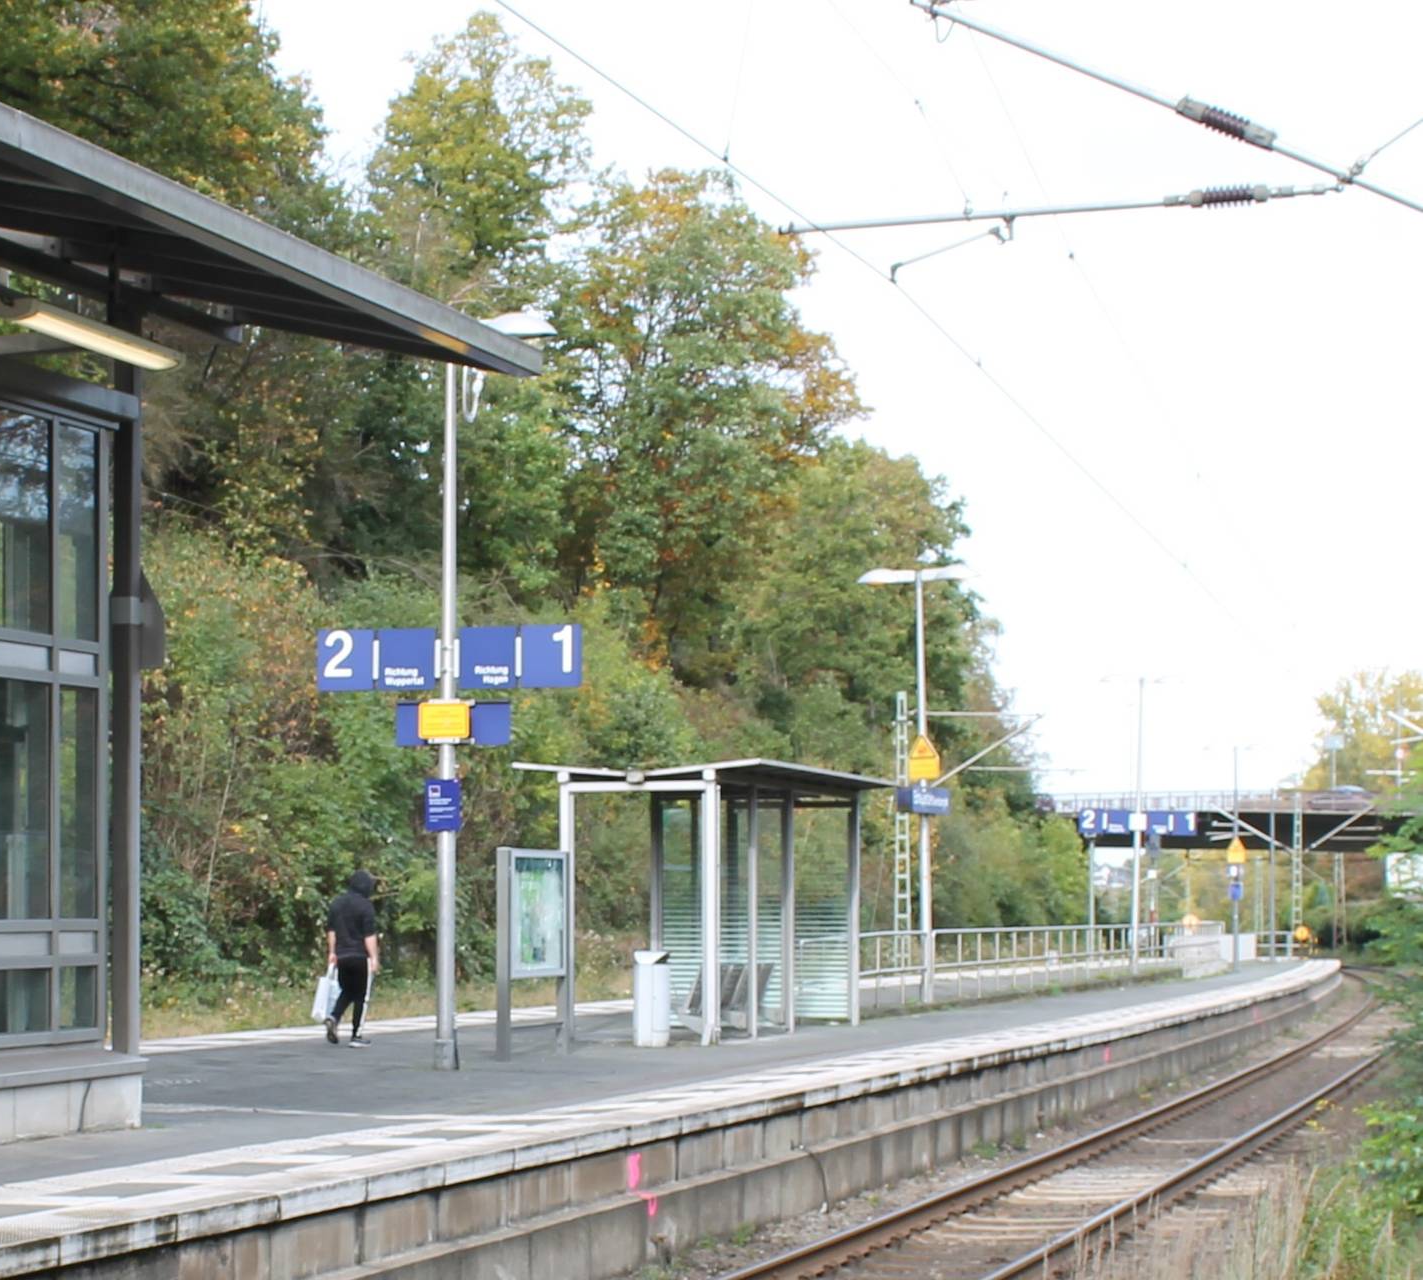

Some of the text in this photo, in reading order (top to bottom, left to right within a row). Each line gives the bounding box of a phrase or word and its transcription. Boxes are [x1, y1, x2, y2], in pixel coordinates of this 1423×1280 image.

[323, 630, 353, 678] 2
[552, 624, 573, 673] 1
[384, 667, 418, 677] Richtung
[474, 665, 509, 675] Richtung
[482, 674, 509, 685] Hagen
[1081, 809, 1096, 829] 2
[1185, 812, 1196, 831] 1
